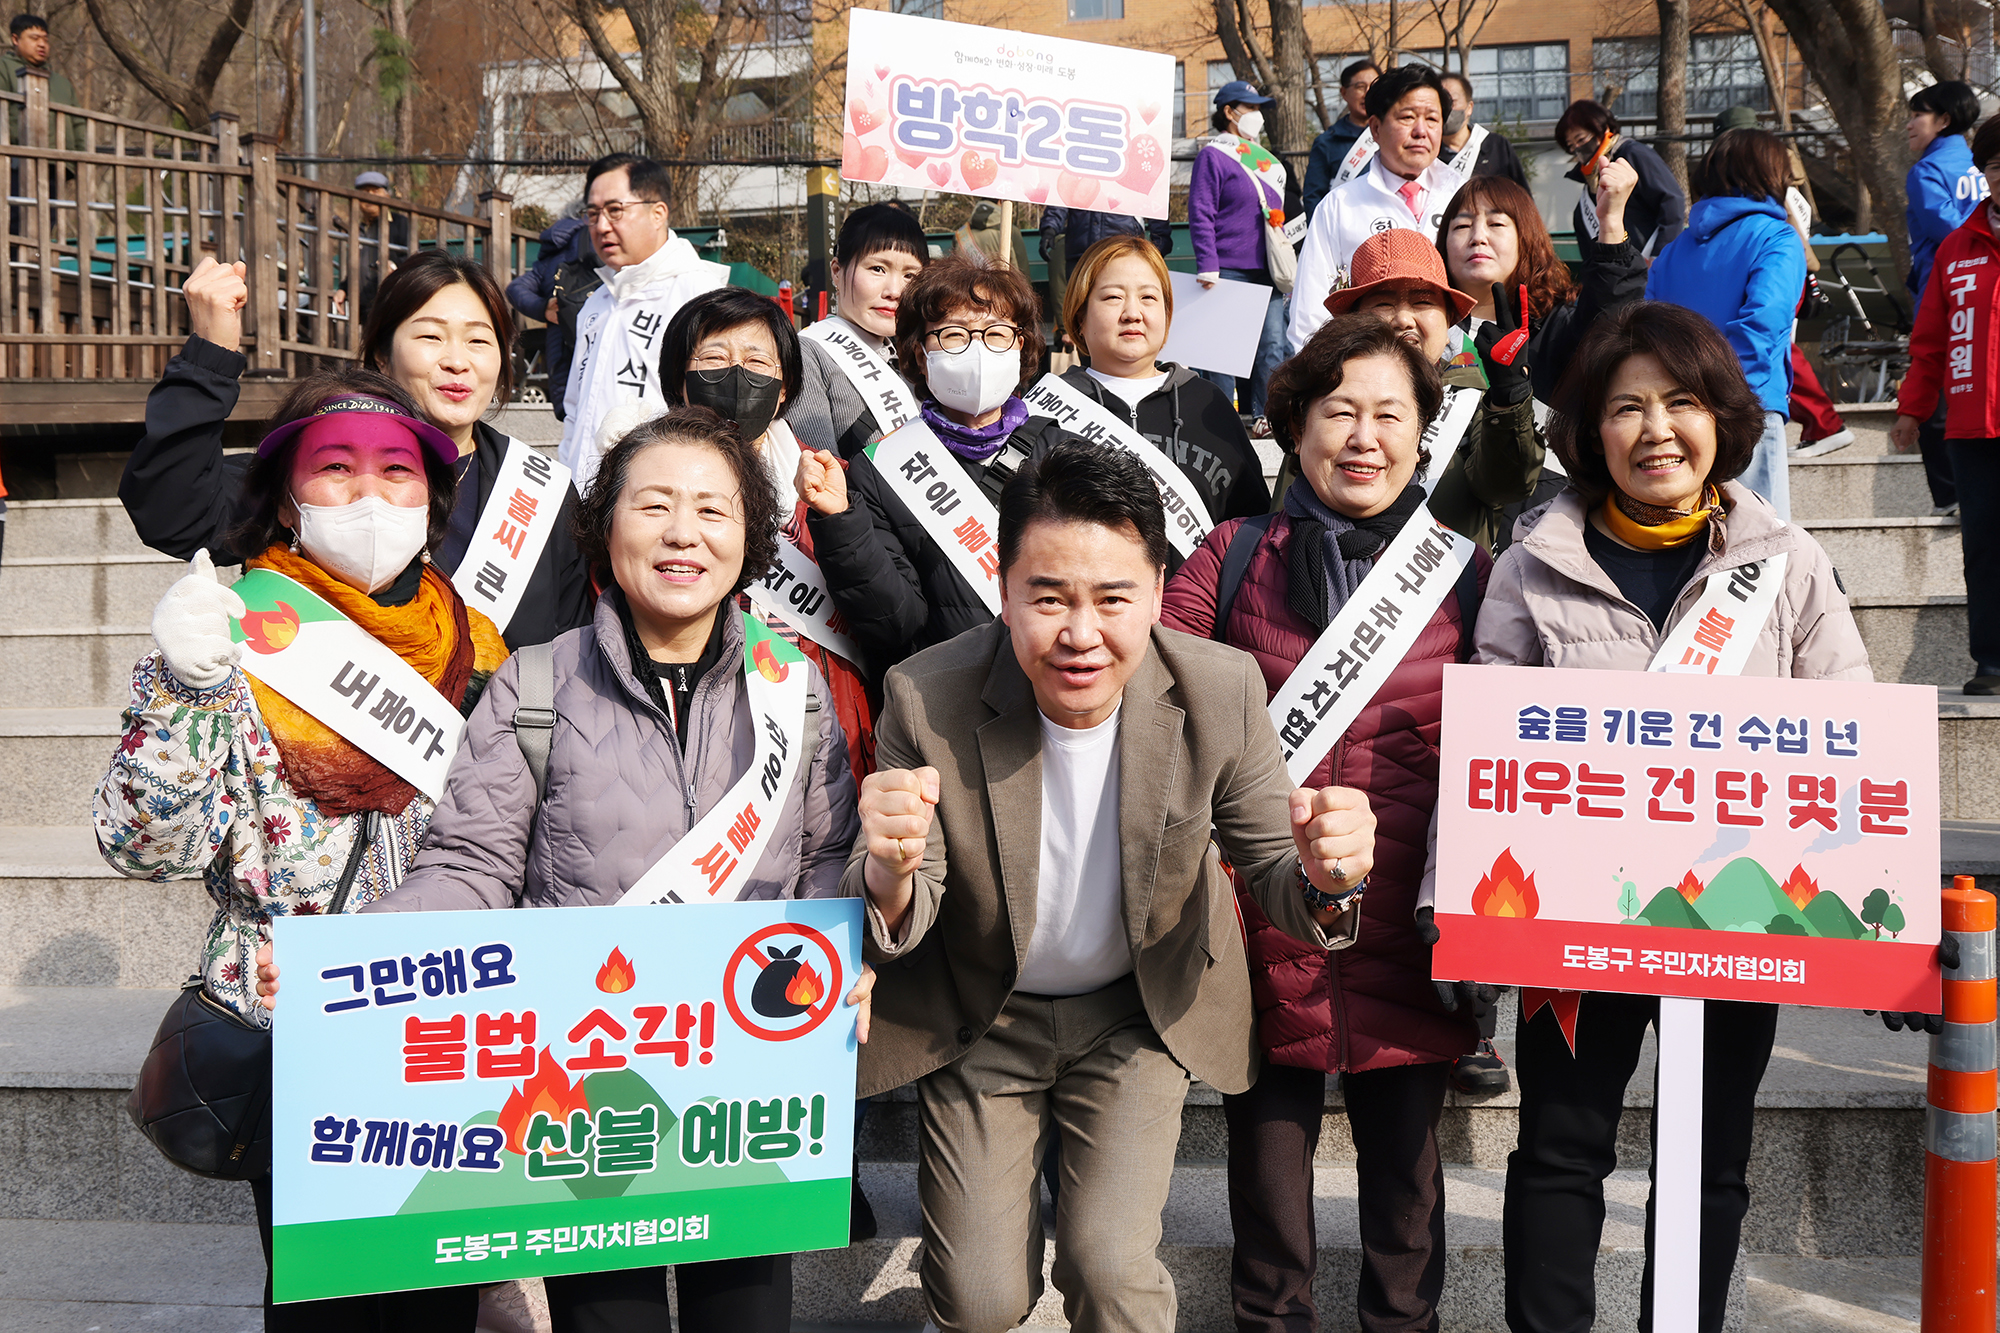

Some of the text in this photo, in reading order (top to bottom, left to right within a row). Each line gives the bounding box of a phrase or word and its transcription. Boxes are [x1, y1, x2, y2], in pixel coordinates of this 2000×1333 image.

[997, 43, 1053, 64] dobong
[1057, 67, 1076, 81] 도봉
[897, 83, 1125, 173] 방학2동
[824, 331, 882, 382] 도봉구
[1949, 273, 1977, 380] 구의원
[323, 402, 347, 412] SINCE
[899, 450, 962, 517] 작은
[473, 454, 552, 603] 은 불씨 큰
[1726, 558, 1768, 603] 은
[329, 660, 446, 762] 도봉구
[1279, 596, 1404, 763] 주민자치협
[1517, 704, 1858, 758] 숲을 키운 건 수십 년
[690, 712, 790, 897] 작은 불씨
[1468, 758, 1911, 837] 태우는 건 단 몇 분
[319, 942, 517, 1014] 그만해요
[1562, 944, 1807, 986] 도봉구 주민자치협의회
[403, 1001, 716, 1084] 불법 소각!
[310, 1093, 826, 1179] 함께해요 산불 예방!
[434, 1214, 711, 1265] 도봉구 주민자치협의회
